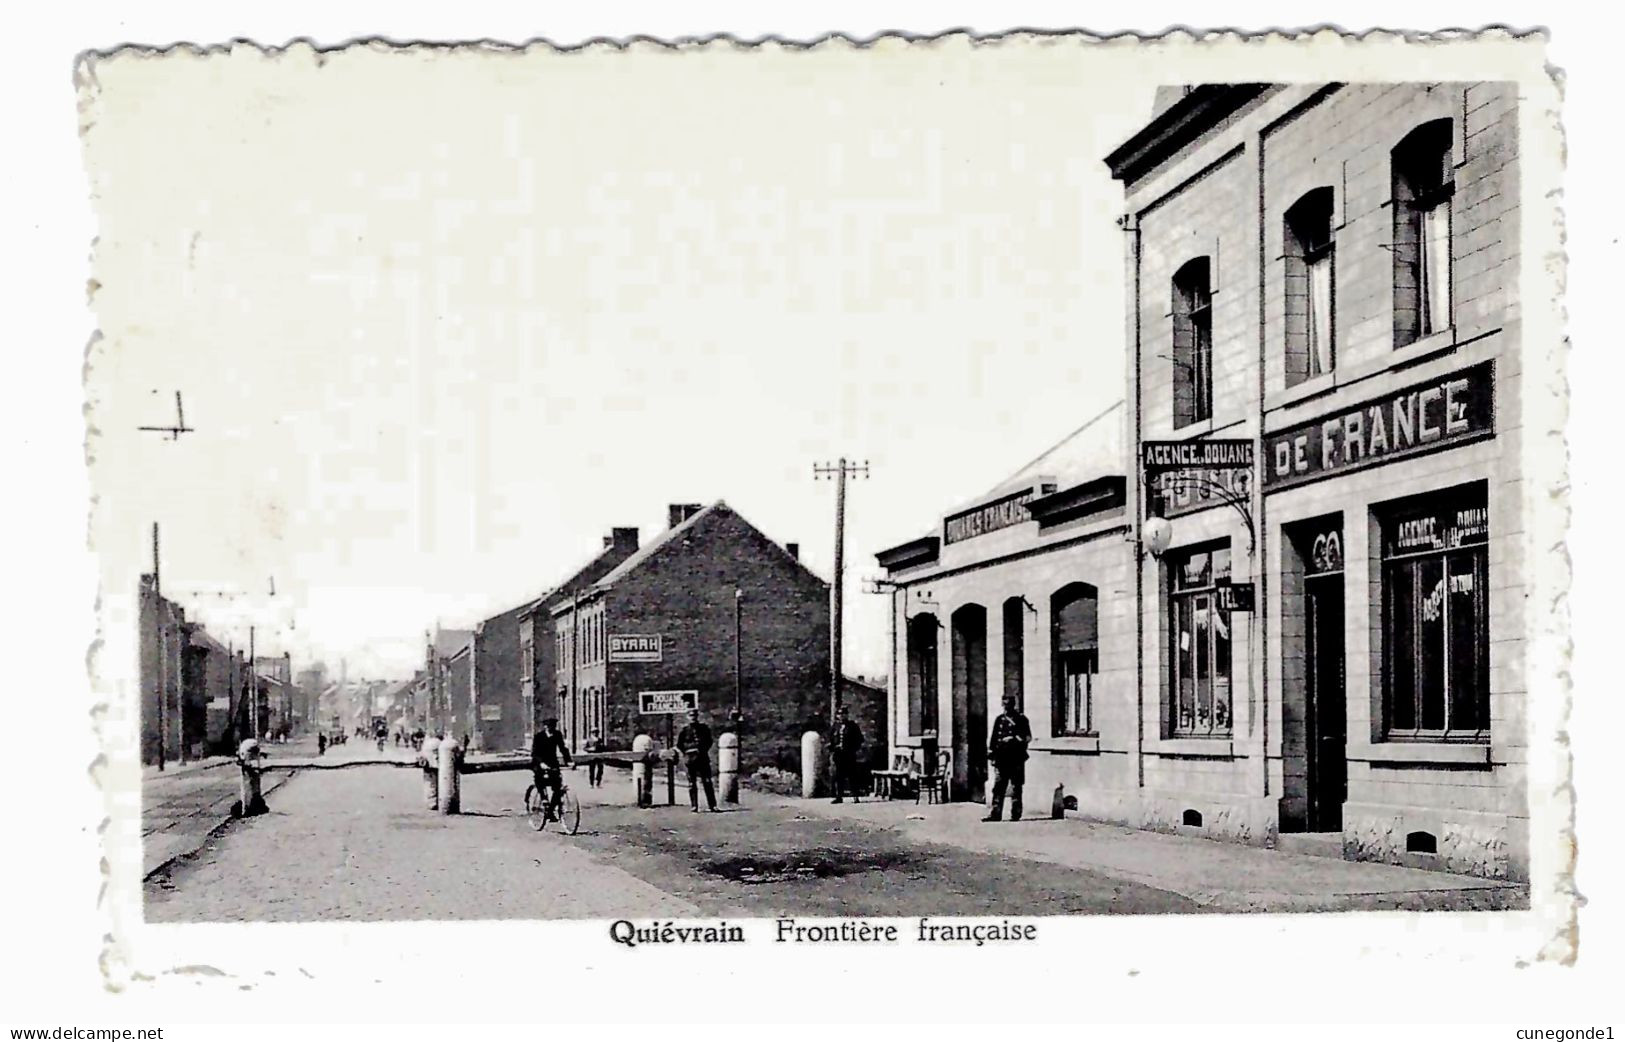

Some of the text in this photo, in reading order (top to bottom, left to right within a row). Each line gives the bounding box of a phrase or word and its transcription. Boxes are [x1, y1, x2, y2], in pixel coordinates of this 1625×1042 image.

[1275, 378, 1469, 476] DE FRANCE
[1146, 444, 1198, 465] AGENCE
[1204, 444, 1252, 464] DOUANE
[612, 638, 658, 650] BYRRH
[653, 693, 684, 703] DOUANE
